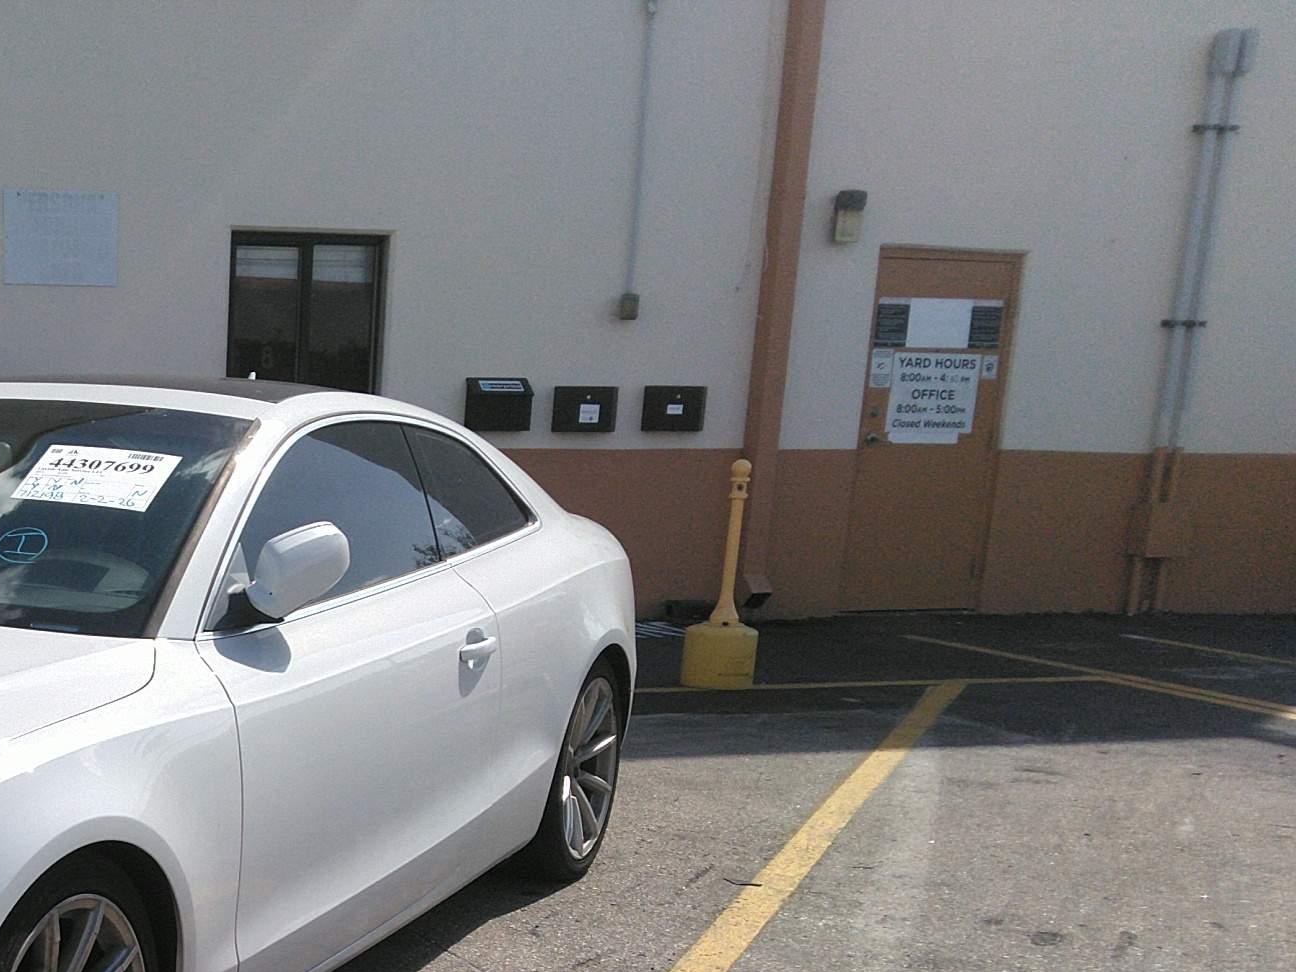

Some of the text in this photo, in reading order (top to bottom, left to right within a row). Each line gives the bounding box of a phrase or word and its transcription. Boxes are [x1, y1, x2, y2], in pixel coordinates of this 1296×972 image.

[899, 357, 976, 370] YARD HOURS
[911, 389, 956, 400] OFFICE
[895, 404, 928, 414] 8:00AM
[935, 404, 966, 415] 5:00PM
[892, 418, 966, 429] Closed Weekends
[48, 456, 155, 475] 44307699
